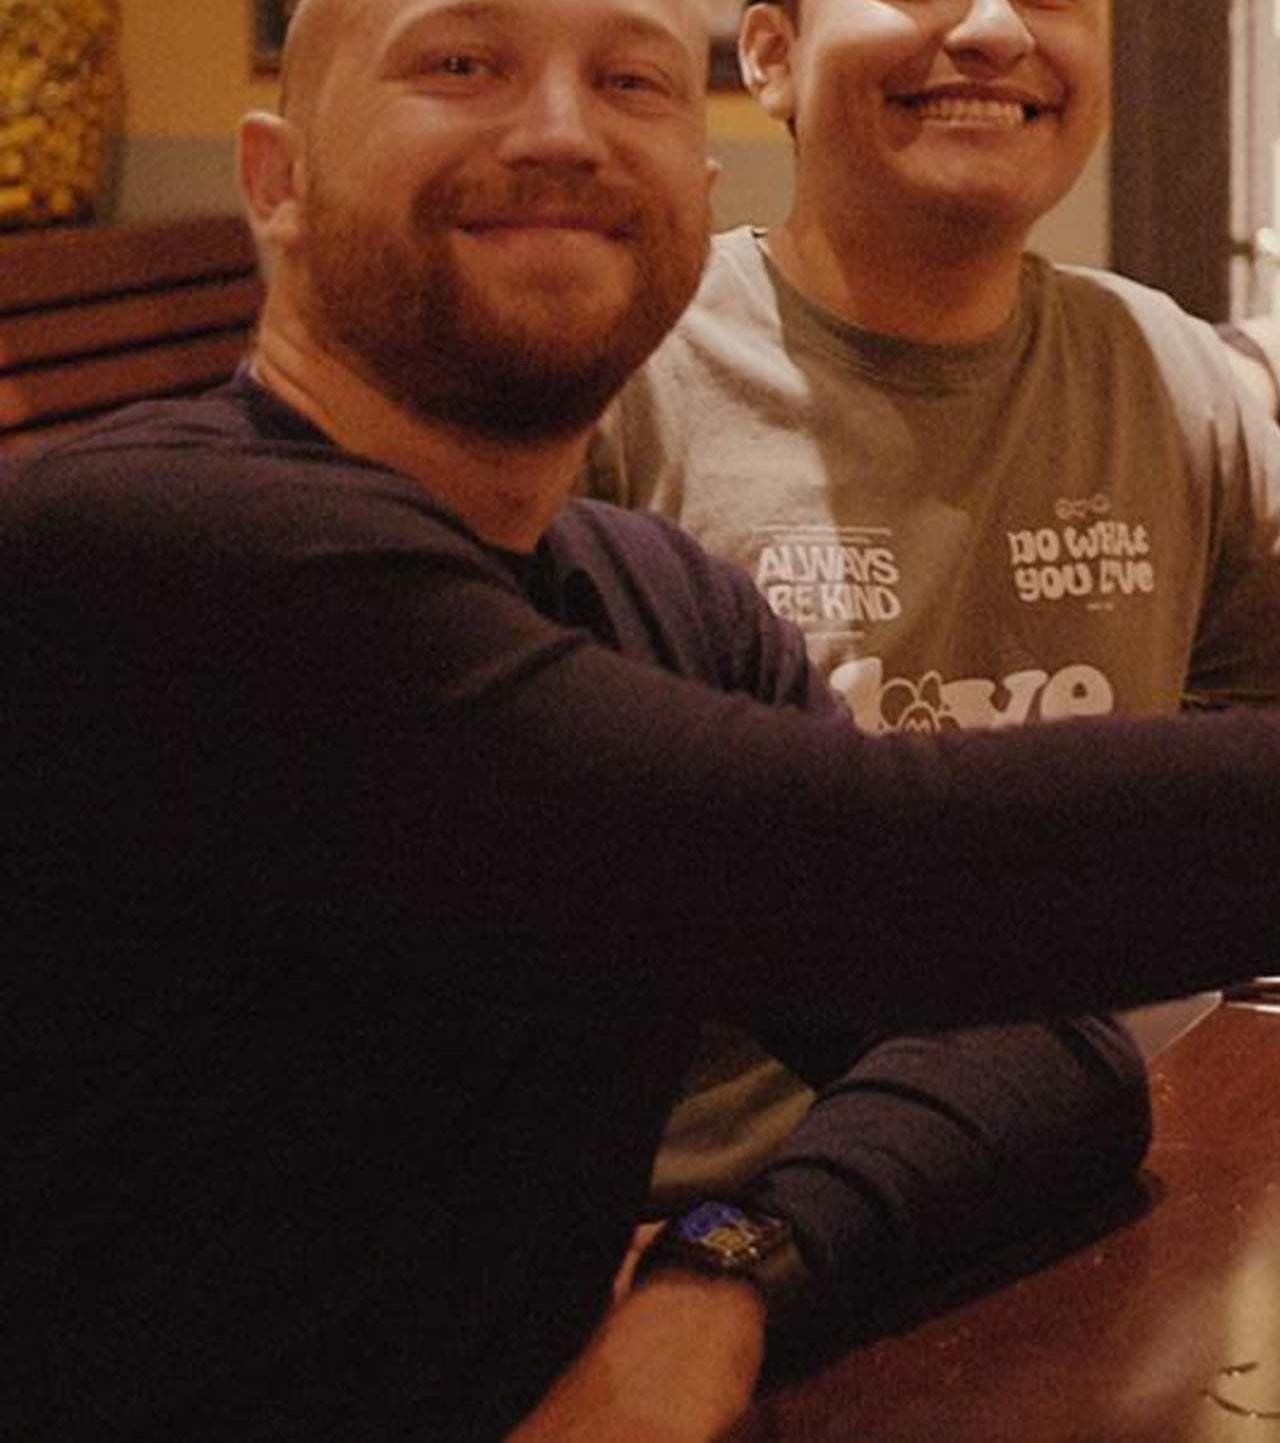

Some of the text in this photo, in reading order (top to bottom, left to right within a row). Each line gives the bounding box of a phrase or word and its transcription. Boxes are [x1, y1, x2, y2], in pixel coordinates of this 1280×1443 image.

[755, 545, 900, 589] ALWAYS
[768, 583, 902, 624] BE KIND
